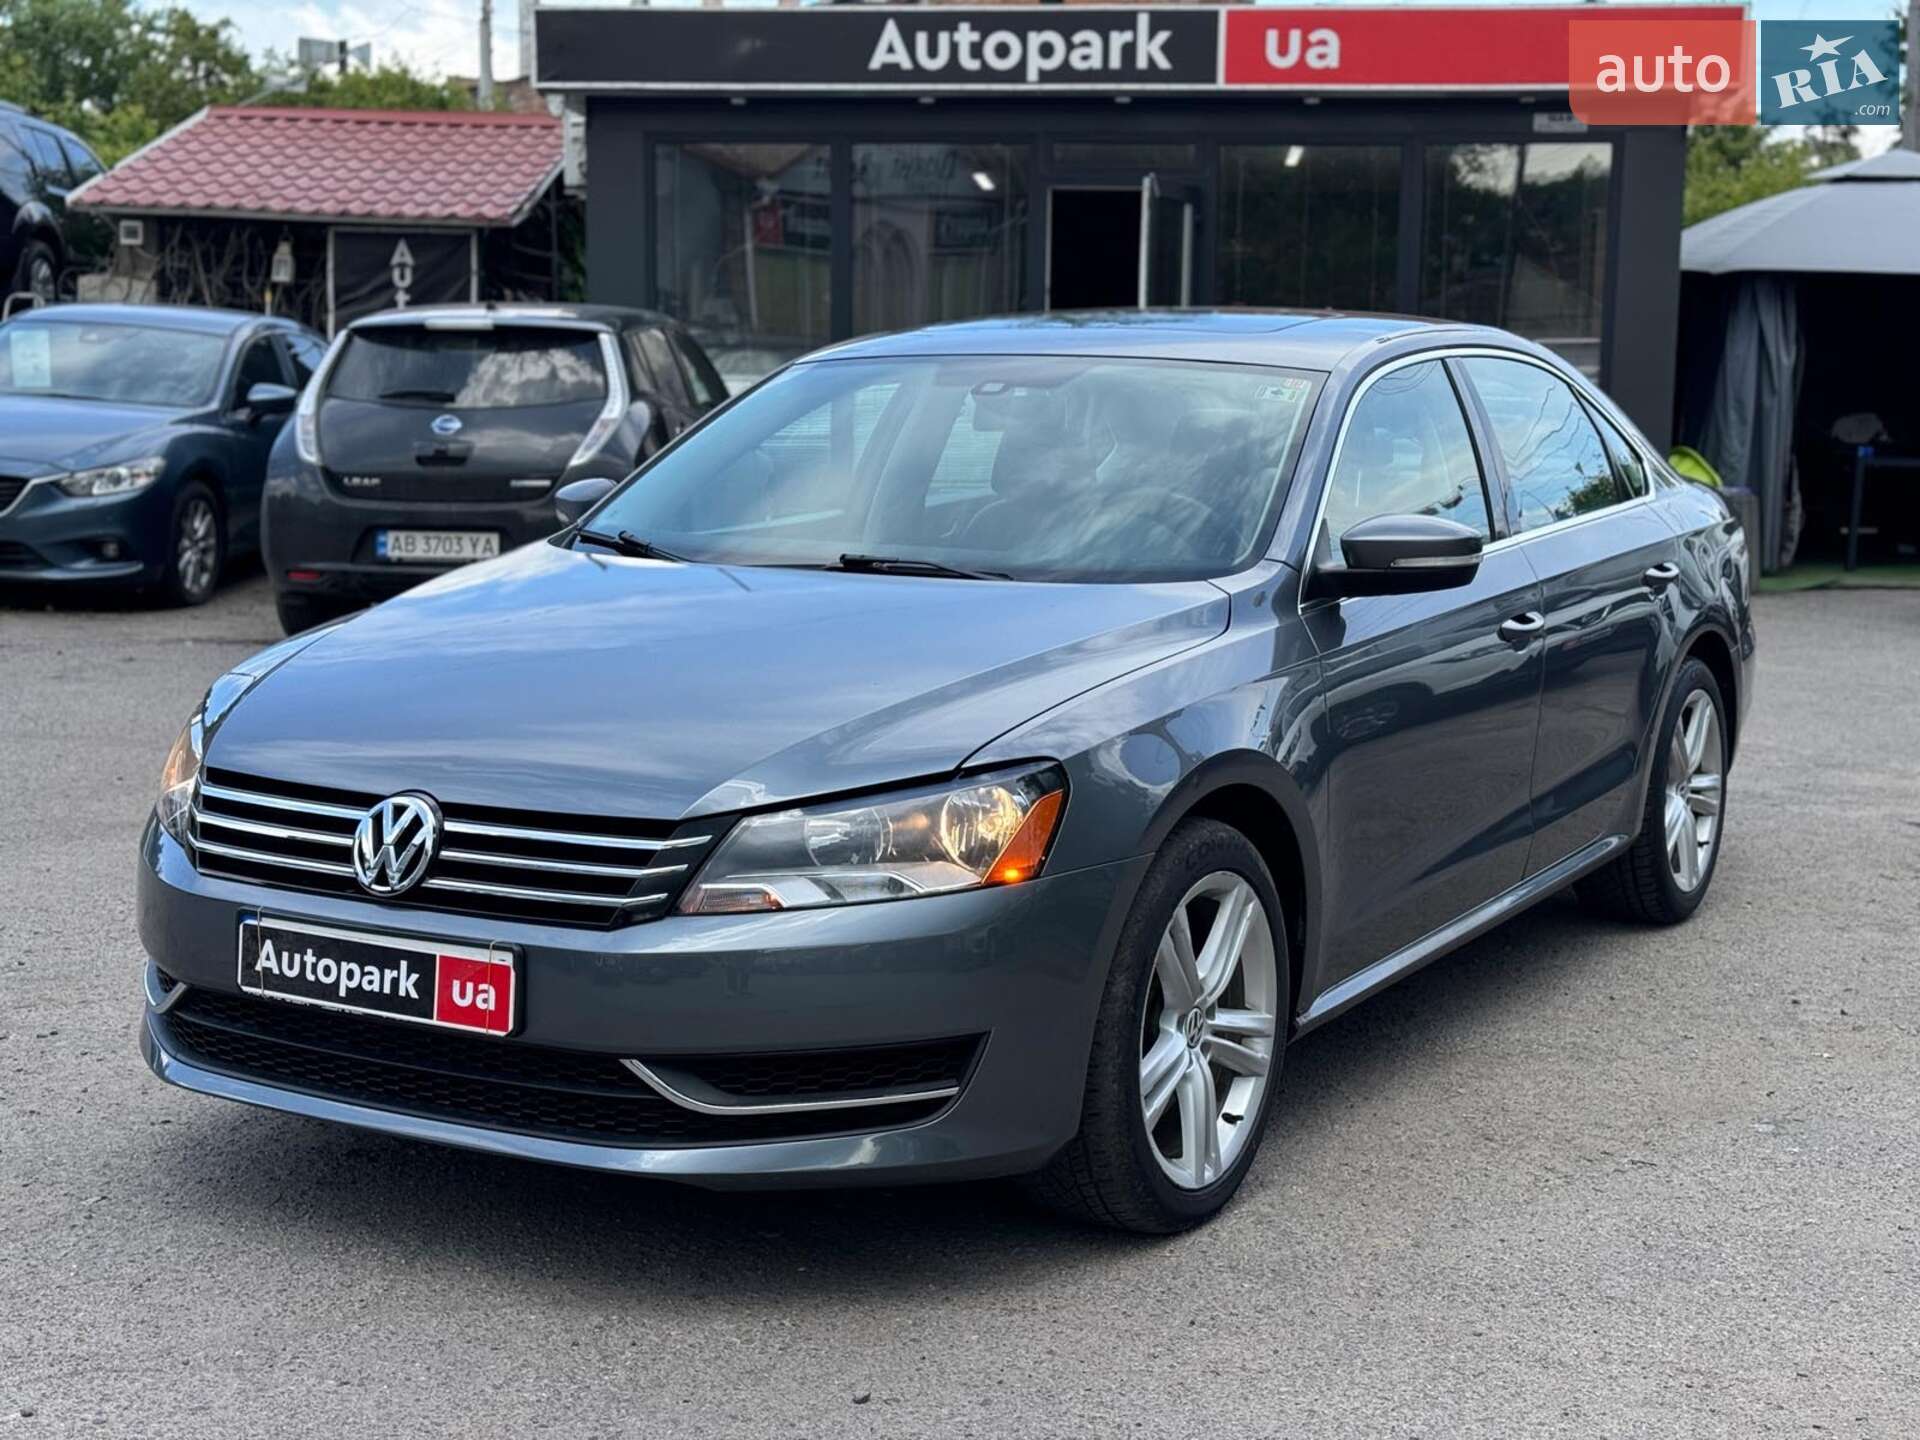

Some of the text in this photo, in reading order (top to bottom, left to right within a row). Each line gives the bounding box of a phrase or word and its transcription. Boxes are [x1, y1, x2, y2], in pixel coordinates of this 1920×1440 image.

[868, 12, 1340, 83] Autopark ua
[391, 534, 495, 555] AB 3703 YA
[255, 939, 496, 1011] Autopark ua
